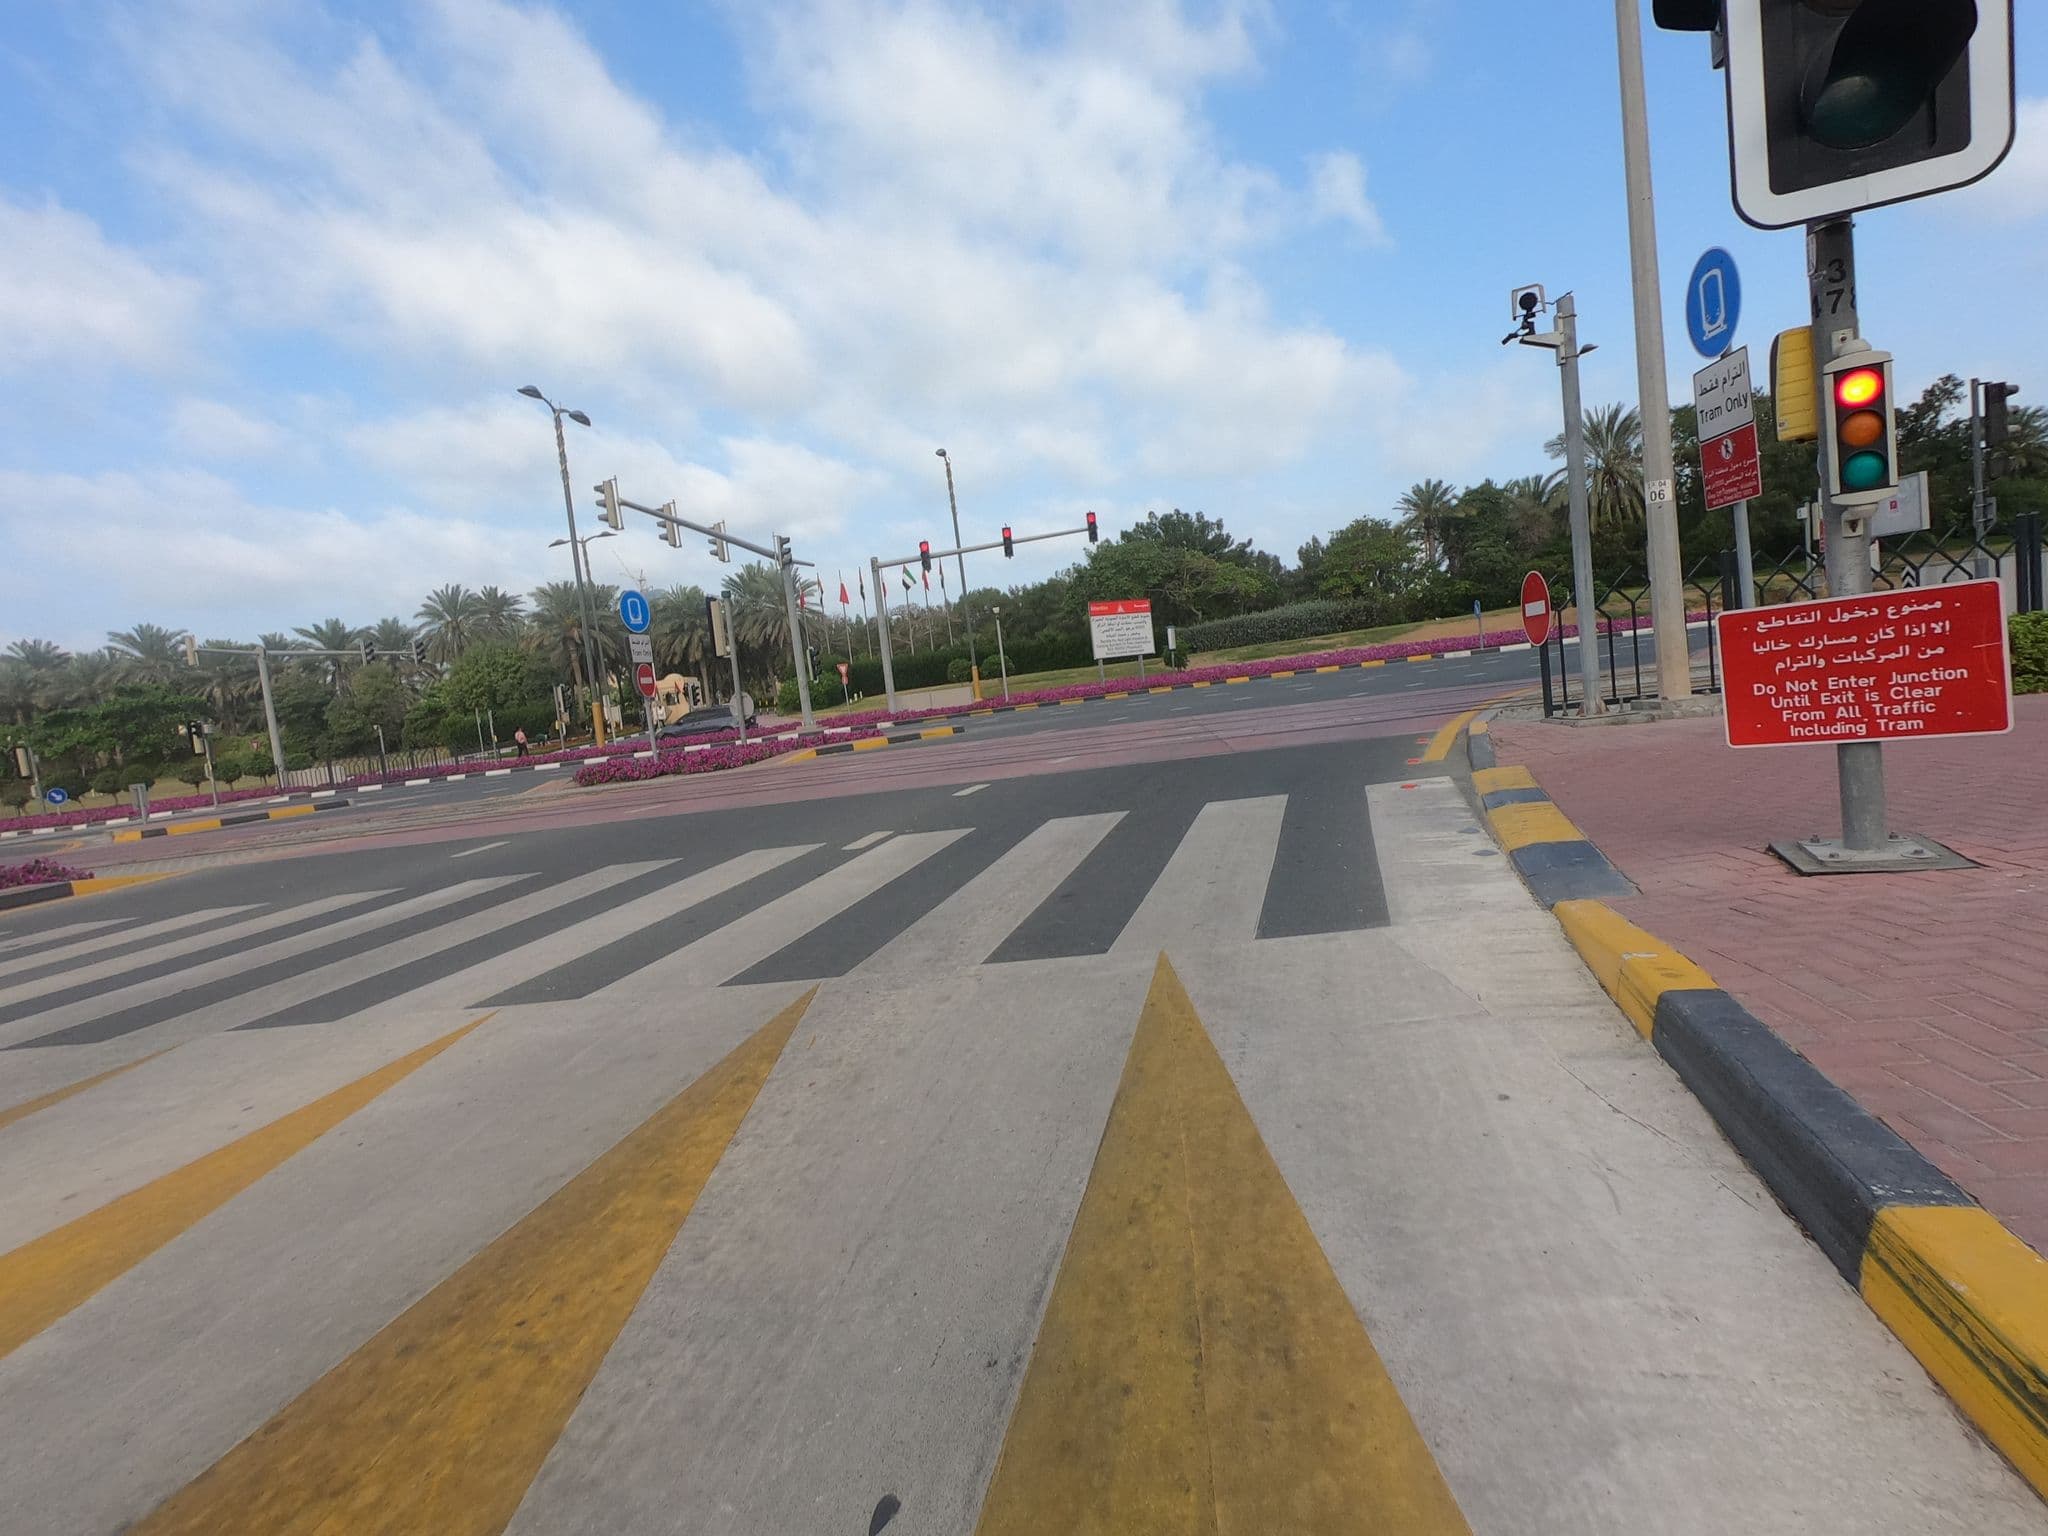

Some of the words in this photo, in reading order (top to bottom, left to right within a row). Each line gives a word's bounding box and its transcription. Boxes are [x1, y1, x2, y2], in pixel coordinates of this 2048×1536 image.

[1698, 376, 1719, 396] فقط
[1722, 361, 1745, 393] الترام
[1699, 406, 1722, 424] Tram
[1725, 392, 1748, 413] Only
[1650, 489, 1665, 502] 06
[1828, 609, 1878, 624] دخول
[1887, 598, 1943, 619] ممنوع
[1756, 611, 1821, 632] التقاطع
[1904, 623, 1925, 637] إذا
[1932, 619, 1950, 635] إلا
[1798, 634, 1858, 652] مسارك
[1865, 627, 1895, 645] كان
[1752, 639, 1791, 654] خاليا
[1832, 645, 1909, 664] المركبات
[1917, 645, 1945, 659] من
[1775, 655, 1826, 675] والترام
[1753, 683, 1777, 696] Do
[1786, 679, 1818, 693] Not
[1828, 675, 1876, 690] Enter
[1888, 667, 1968, 685] Junction
[1771, 694, 1811, 709] Until
[1821, 690, 1854, 707] Exit
[1865, 689, 1879, 701] is
[1890, 684, 1943, 699] Clear
[1783, 708, 1825, 722] From
[1835, 704, 1860, 718] All
[1873, 701, 1936, 716] Traffic
[1790, 718, 1867, 737] Including
[1876, 717, 1924, 731] Tram
